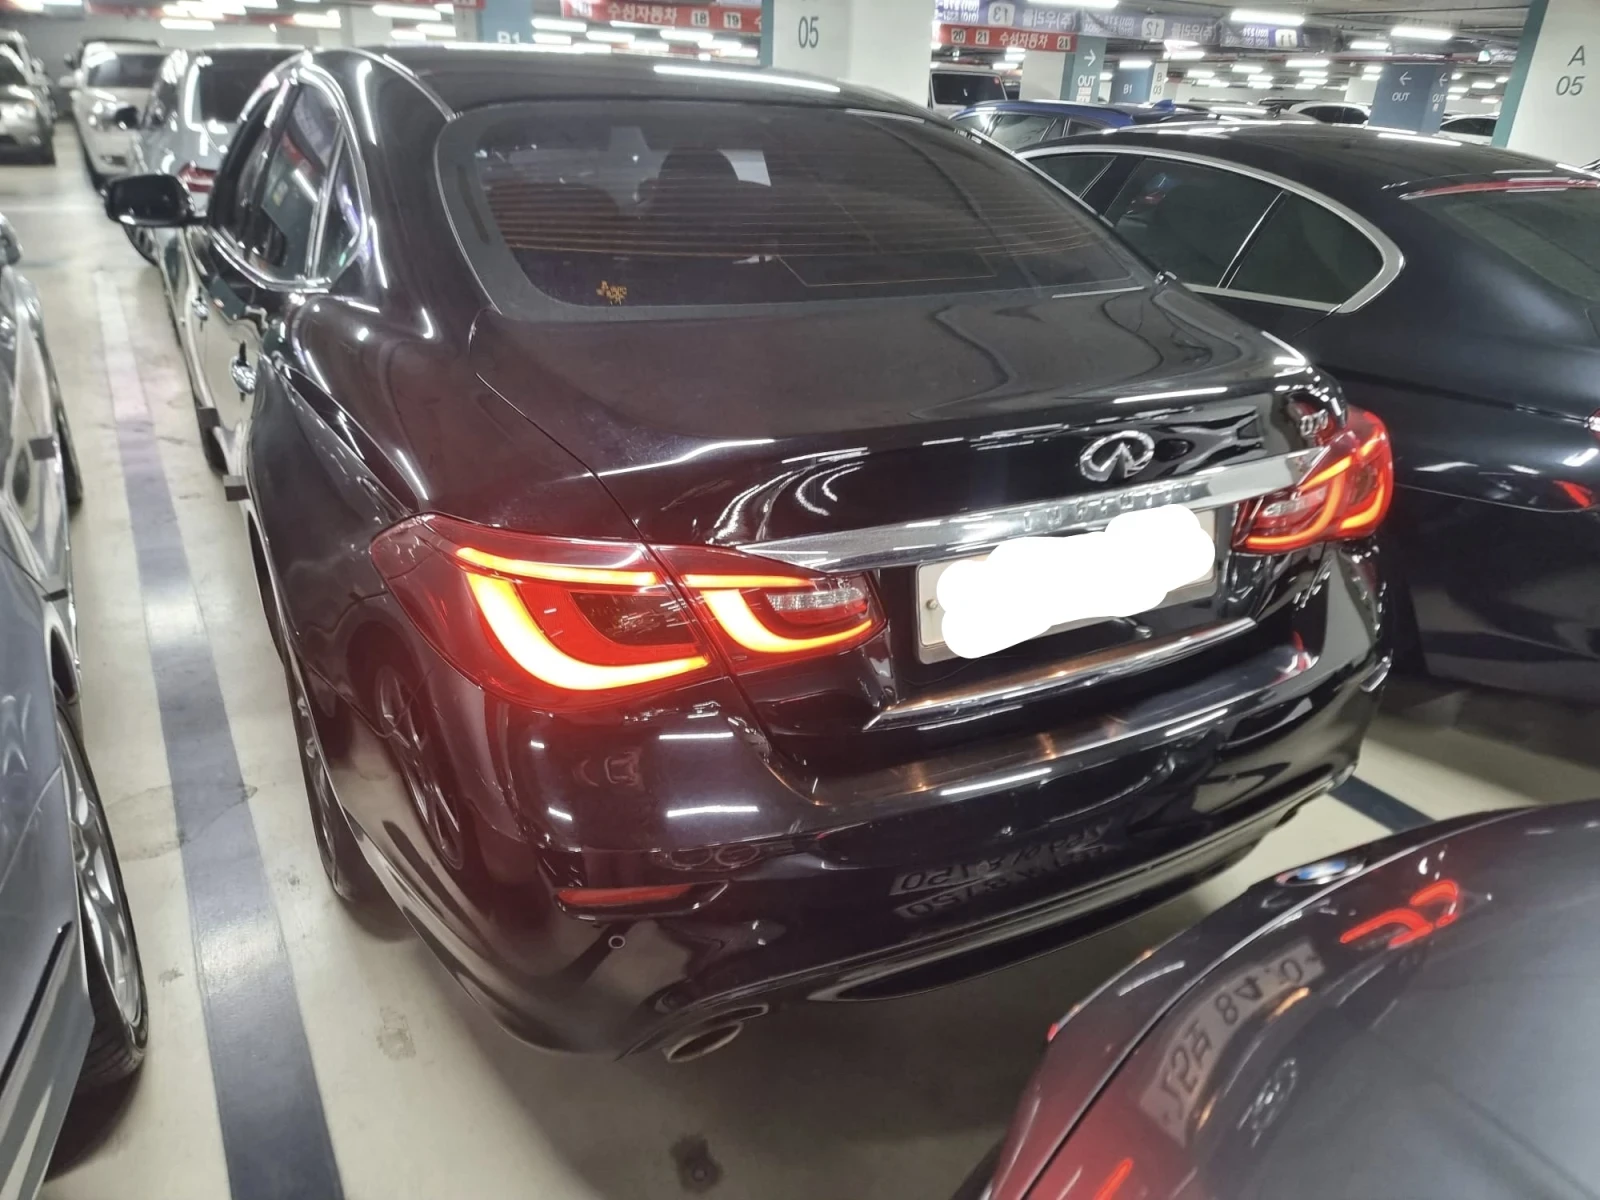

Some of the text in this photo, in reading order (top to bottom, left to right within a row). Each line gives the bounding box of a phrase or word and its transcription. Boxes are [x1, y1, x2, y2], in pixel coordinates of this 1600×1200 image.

[607, 3, 678, 24] 수성자동차
[798, 16, 819, 49] 05
[953, 30, 965, 41] 20
[999, 31, 1048, 49] 수성자동차
[1568, 45, 1586, 67] A
[1077, 75, 1096, 87] OUT
[1555, 75, 1586, 96] 05
[1391, 92, 1411, 102] OUT
[1432, 93, 1446, 104] OUT
